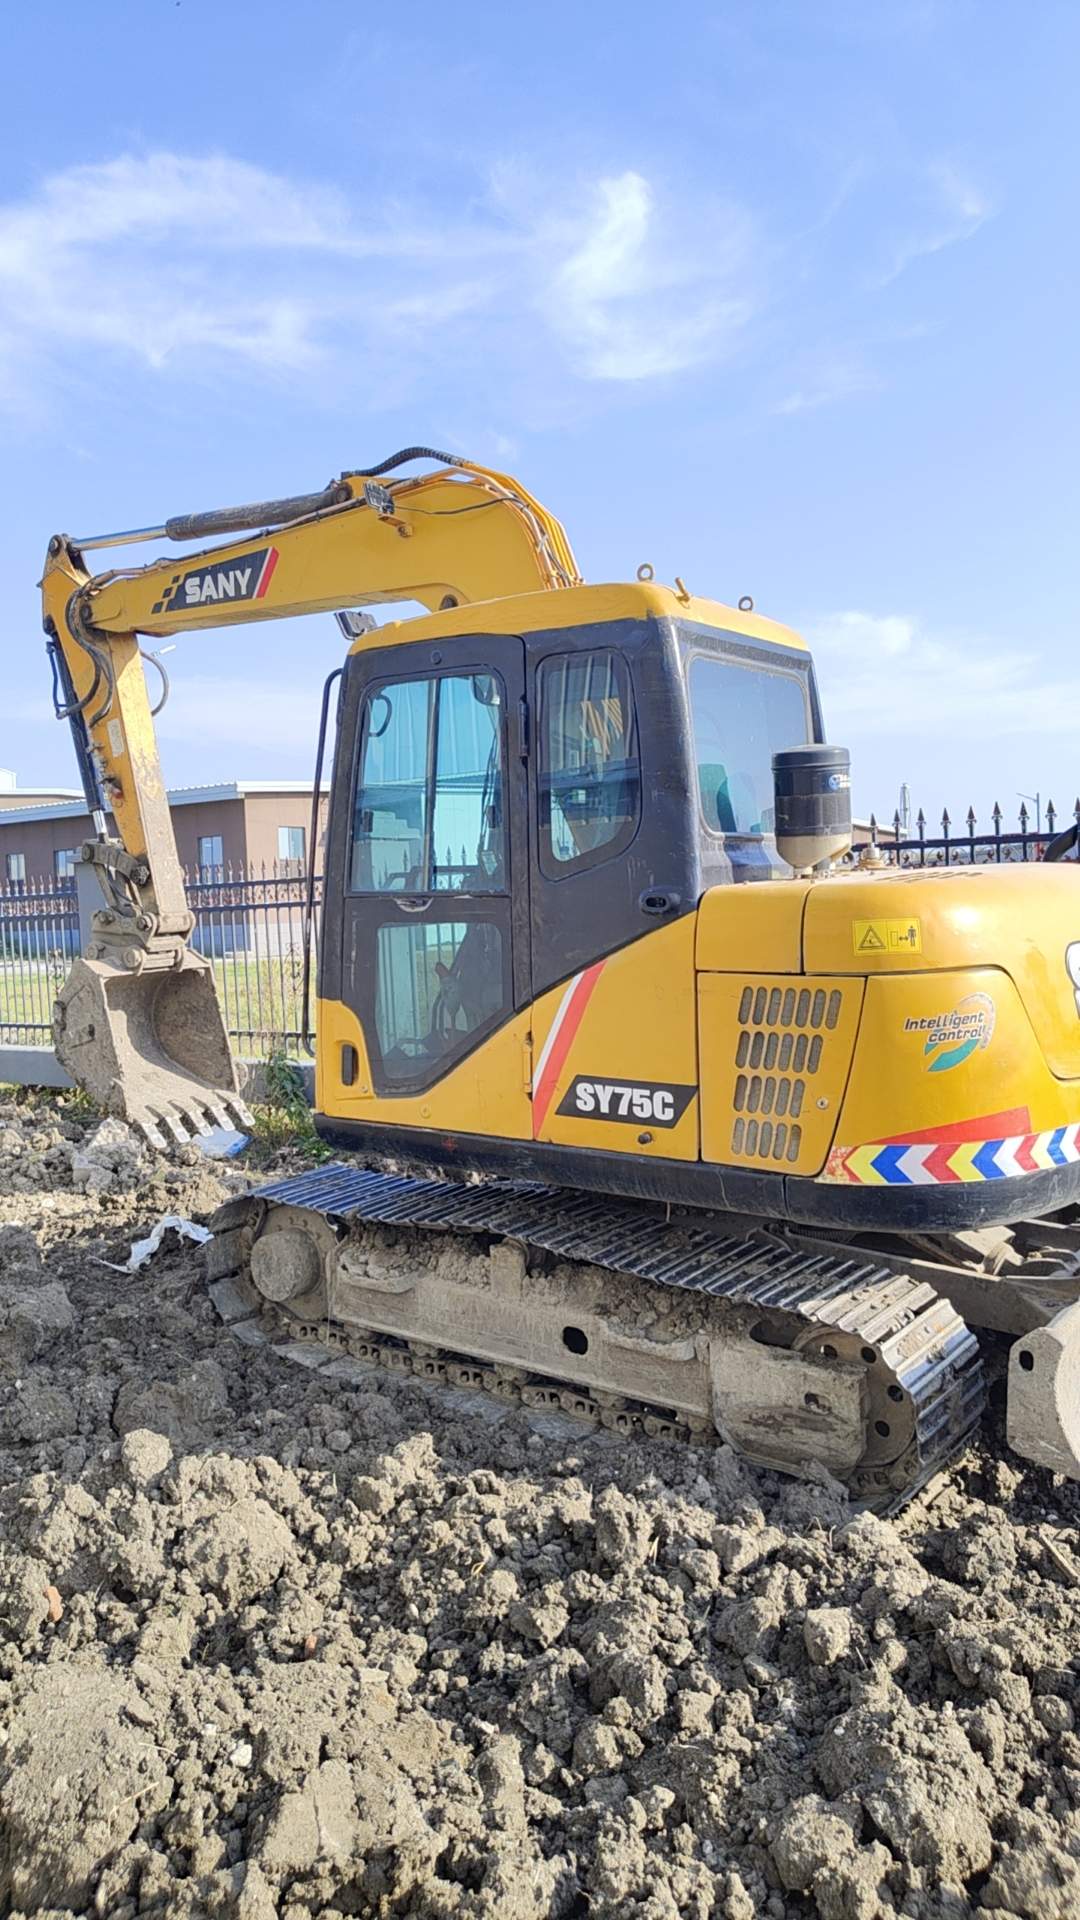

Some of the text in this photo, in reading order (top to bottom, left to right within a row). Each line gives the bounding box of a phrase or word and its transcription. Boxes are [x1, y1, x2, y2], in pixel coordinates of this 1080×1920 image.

[185, 568, 251, 603] SANY
[904, 1011, 984, 1030] Intelligent
[928, 1025, 984, 1042] control
[576, 1083, 674, 1120] SY75C
